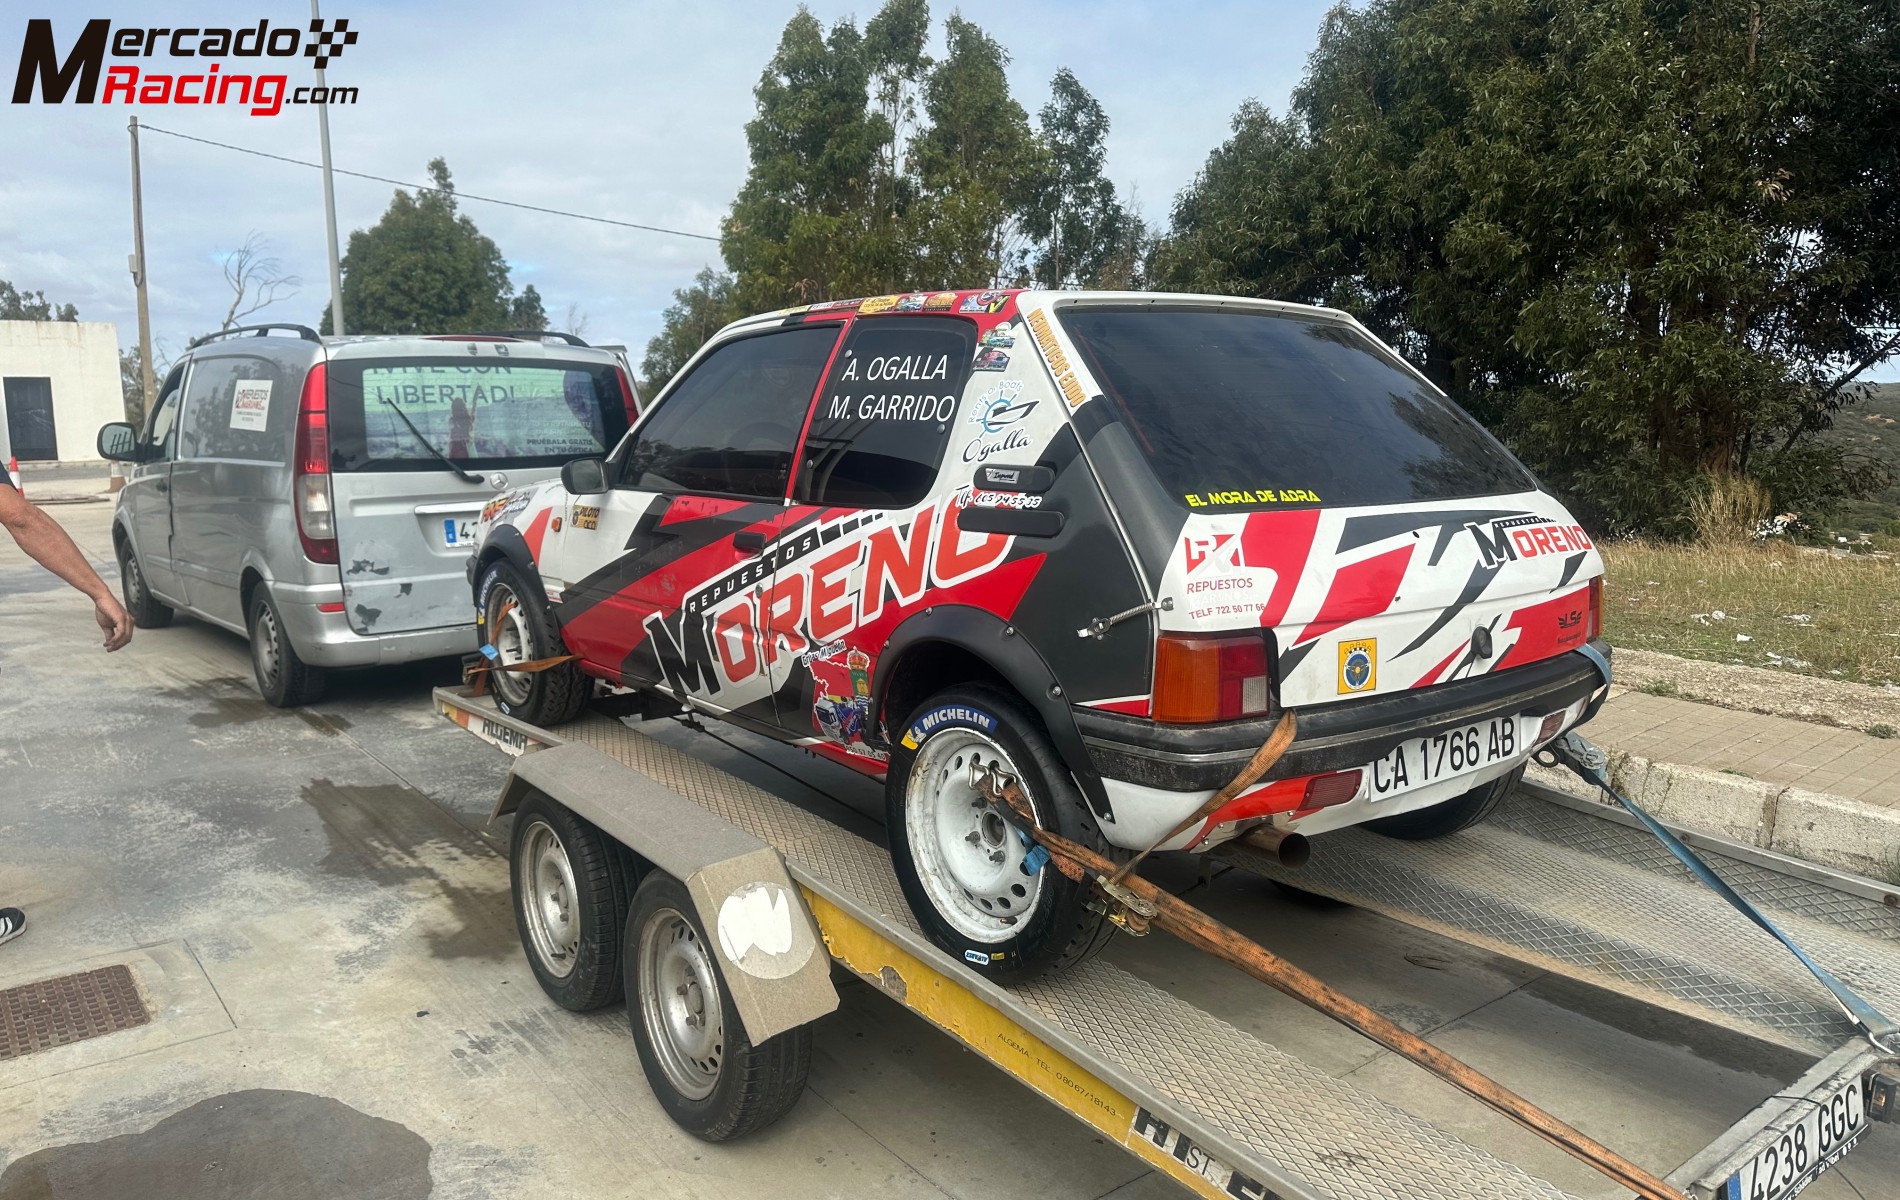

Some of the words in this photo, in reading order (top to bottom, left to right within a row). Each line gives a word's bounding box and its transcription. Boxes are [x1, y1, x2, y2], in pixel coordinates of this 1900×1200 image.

[841, 358, 860, 381] A.
[867, 355, 948, 381] OGALLA
[376, 384, 514, 404] LIBERTAD!
[828, 396, 851, 420] M.
[858, 395, 956, 422] GARRIDO
[962, 429, 1033, 463] Ogalla
[1185, 494, 1208, 507] EL
[1208, 491, 1257, 504] MORA
[1256, 490, 1277, 502] DE
[1279, 490, 1321, 502] ADRA
[1467, 525, 1592, 568] MORENO
[689, 536, 812, 614] REPUESTOS
[1186, 577, 1253, 594] REPUESTOS
[645, 496, 1010, 697] MORENO
[1189, 608, 1213, 620] TELF
[1216, 605, 1231, 615] 722
[1232, 604, 1243, 613] 50
[1243, 603, 1253, 612] 77
[922, 707, 991, 730] MICHELIN
[1373, 745, 1409, 793] CA
[1421, 726, 1480, 780] 1766
[1487, 716, 1515, 762] AB
[997, 1033, 1030, 1058] ALGEMA
[1750, 1123, 1809, 1200] 4238
[1818, 1084, 1860, 1153] GGC
